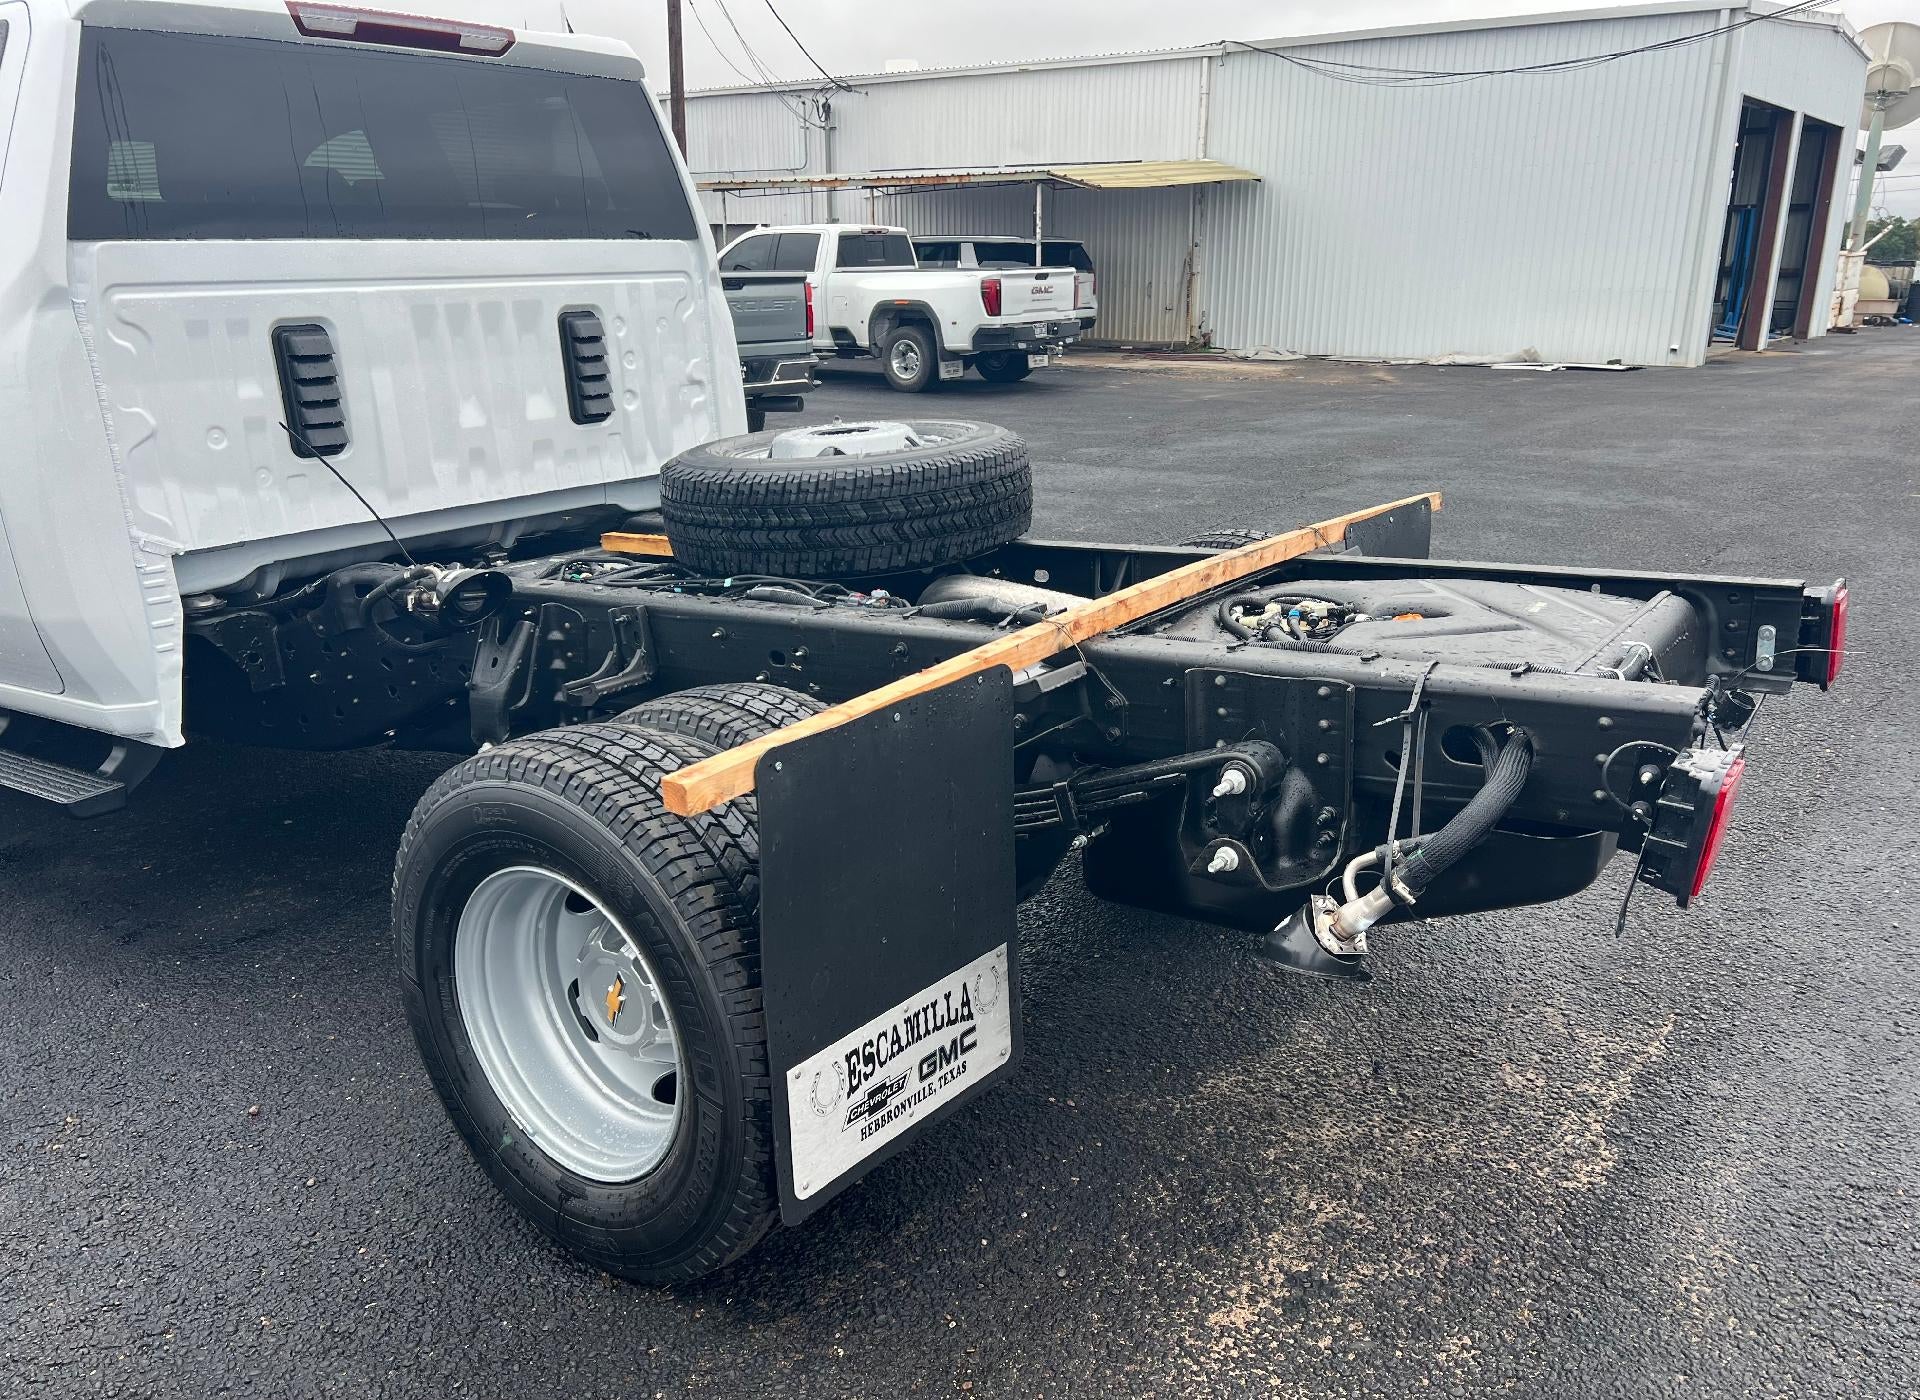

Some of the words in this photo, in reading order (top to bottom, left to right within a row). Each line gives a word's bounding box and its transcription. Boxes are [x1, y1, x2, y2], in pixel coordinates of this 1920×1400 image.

[728, 300, 797, 312] ROLET
[1031, 286, 1053, 295] GMC
[633, 911, 719, 1092] MICHELIN
[845, 981, 974, 1100] ESCAMILLA
[917, 1024, 978, 1083] GMC
[850, 1075, 908, 1120] CHEVROLET
[860, 1082, 937, 1142] HEBBRONVILLE,
[938, 1060, 967, 1090] TEXAS
